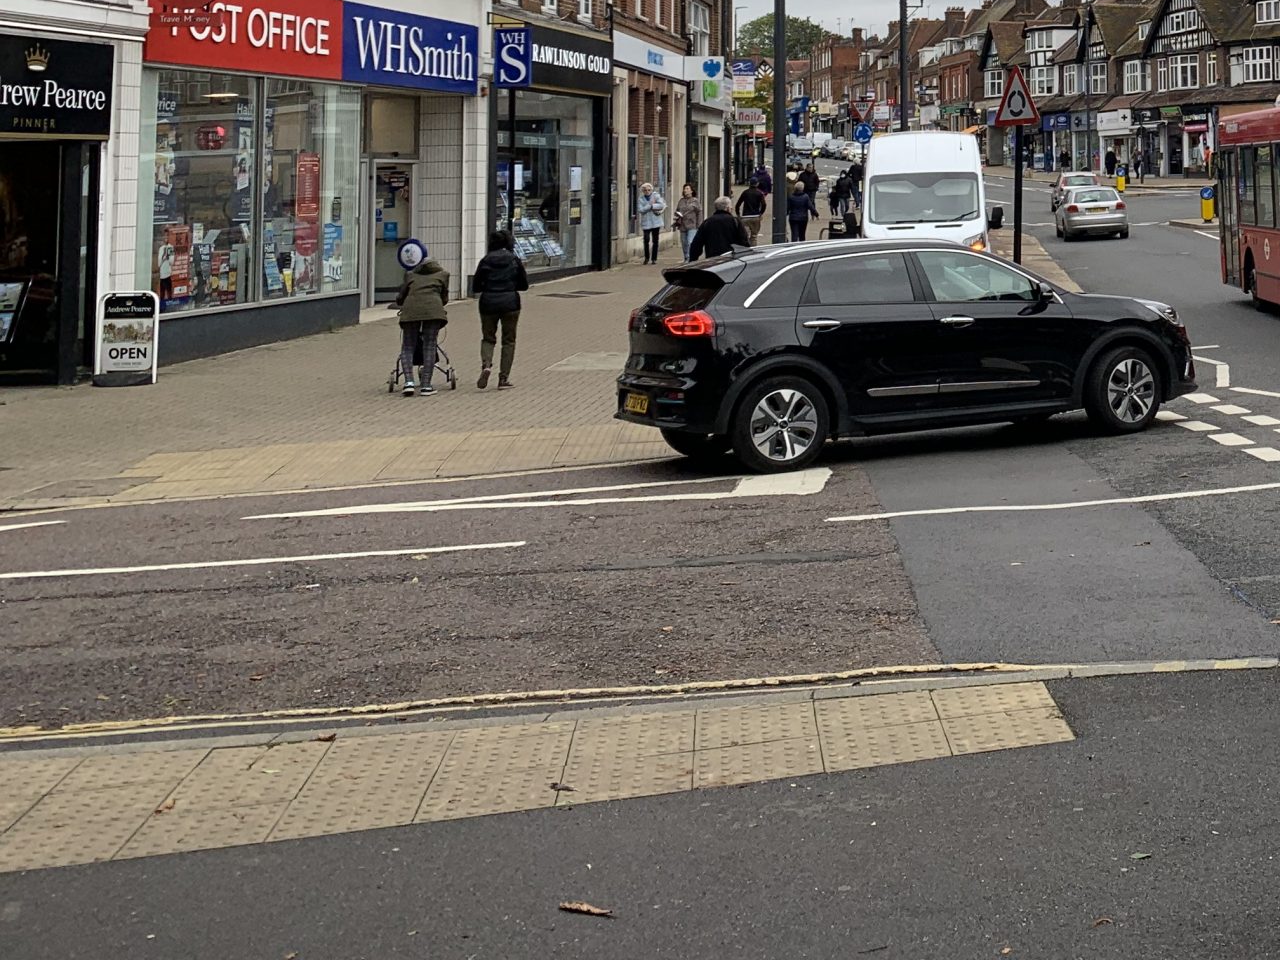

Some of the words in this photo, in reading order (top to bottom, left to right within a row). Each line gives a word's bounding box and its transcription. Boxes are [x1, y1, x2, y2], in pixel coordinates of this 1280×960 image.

[160, 15, 182, 23] Trave
[184, 15, 210, 24] Mney
[247, 8, 330, 55] OFFICE
[500, 32, 525, 44] WH
[353, 17, 474, 81] WHSmith
[500, 44, 527, 83] S
[532, 44, 586, 70] RAWLINSON
[588, 55, 610, 74] GOLD
[0, 75, 41, 107] rew
[42, 80, 106, 110] Pearce
[157, 98, 176, 110] rice
[13, 117, 56, 129] PINNER
[131, 305, 152, 313] Pearce
[108, 347, 148, 360] OPEN
